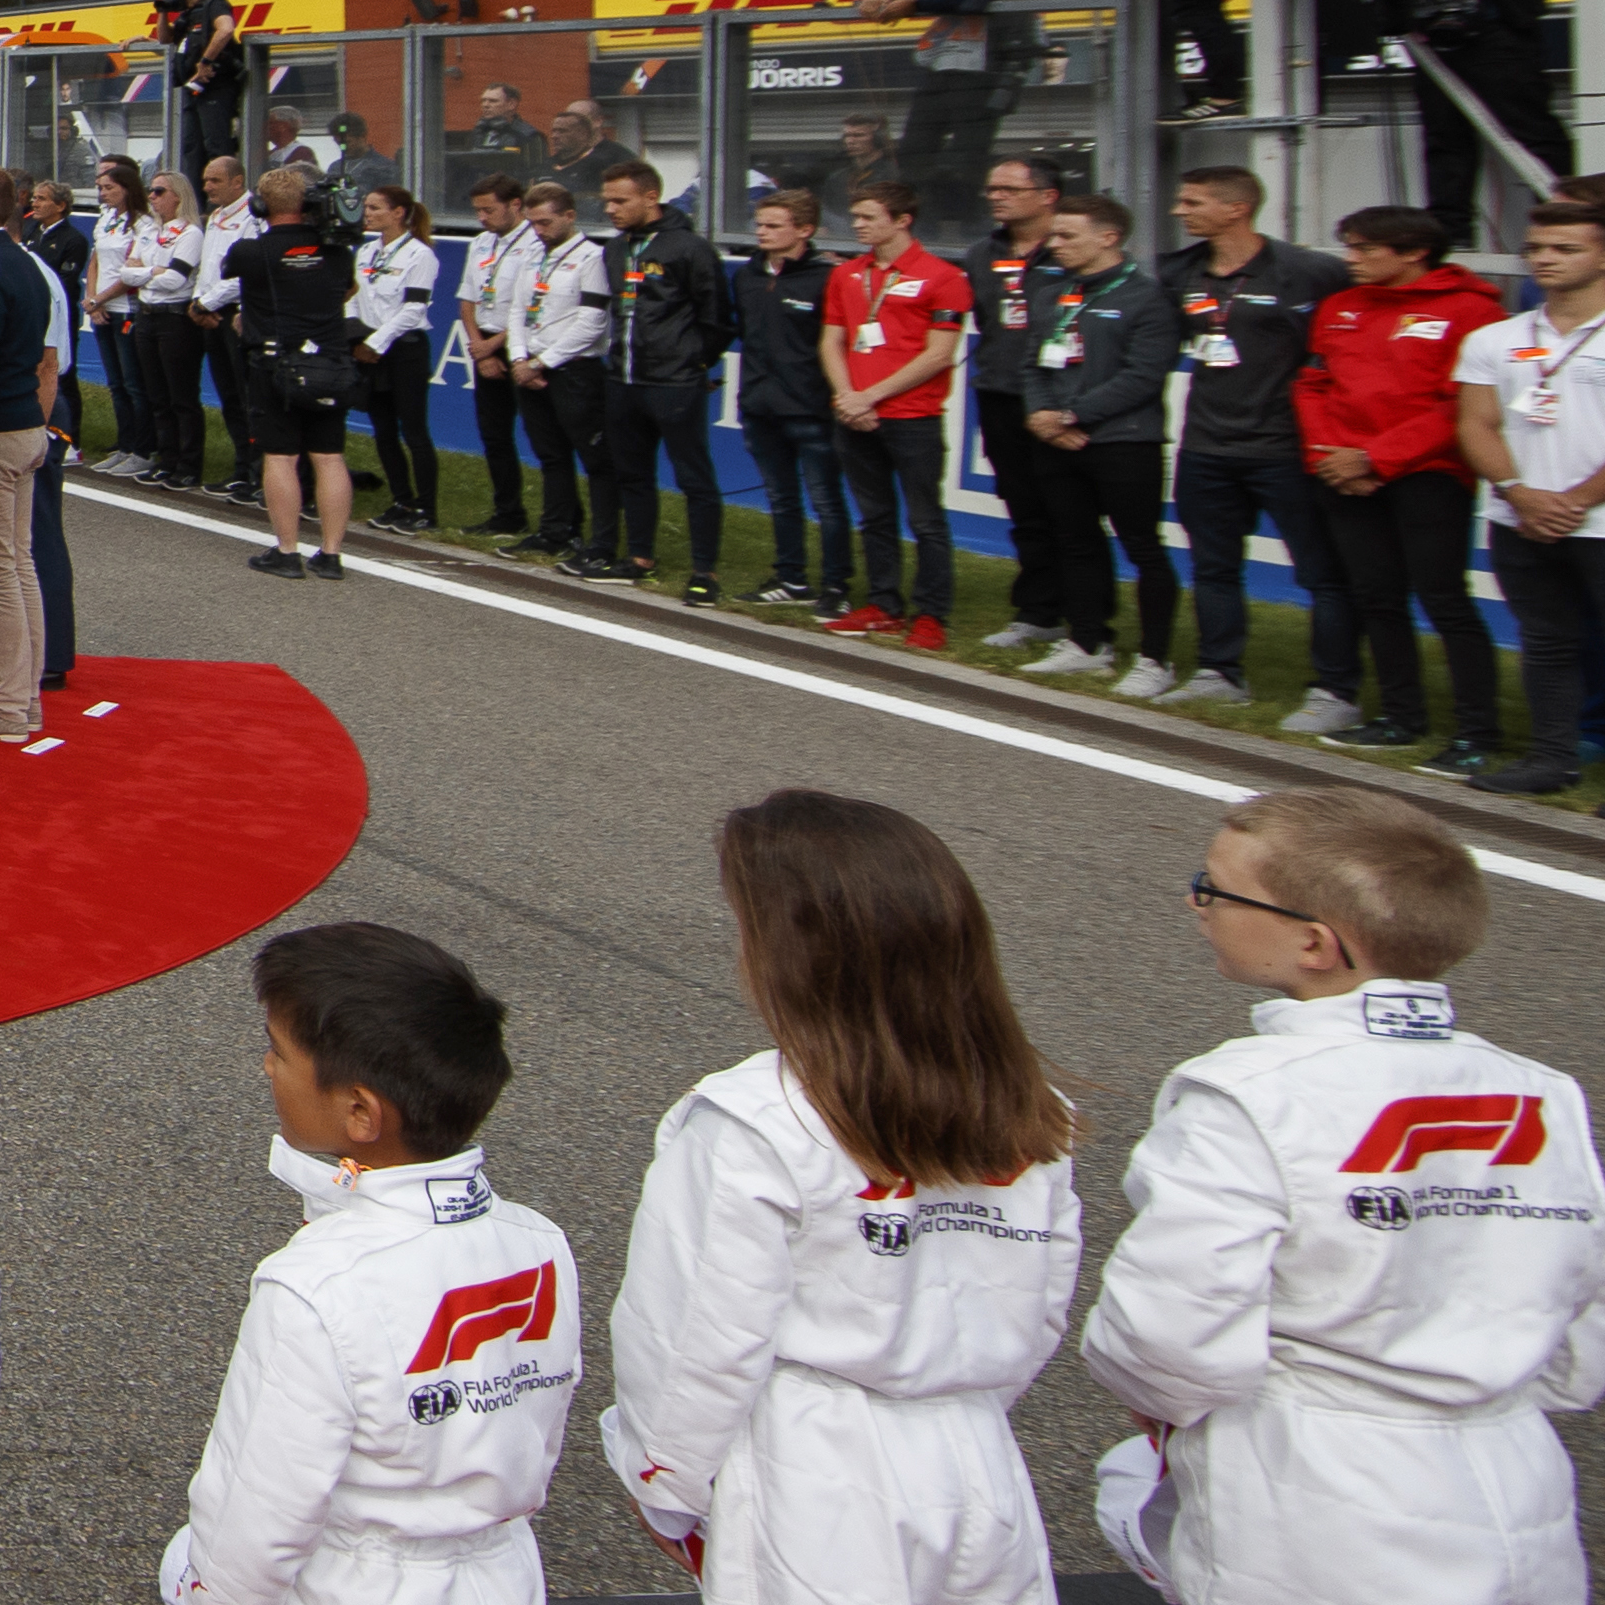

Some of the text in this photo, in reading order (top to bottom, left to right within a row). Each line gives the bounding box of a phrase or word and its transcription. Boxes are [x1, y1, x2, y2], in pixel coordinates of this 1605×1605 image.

[1507, 1184, 1520, 1199] 1
[918, 1201, 1007, 1222] Formula 1
[463, 1379, 493, 1395] FIA
[531, 1359, 540, 1374] 1
[466, 1393, 513, 1413] World
